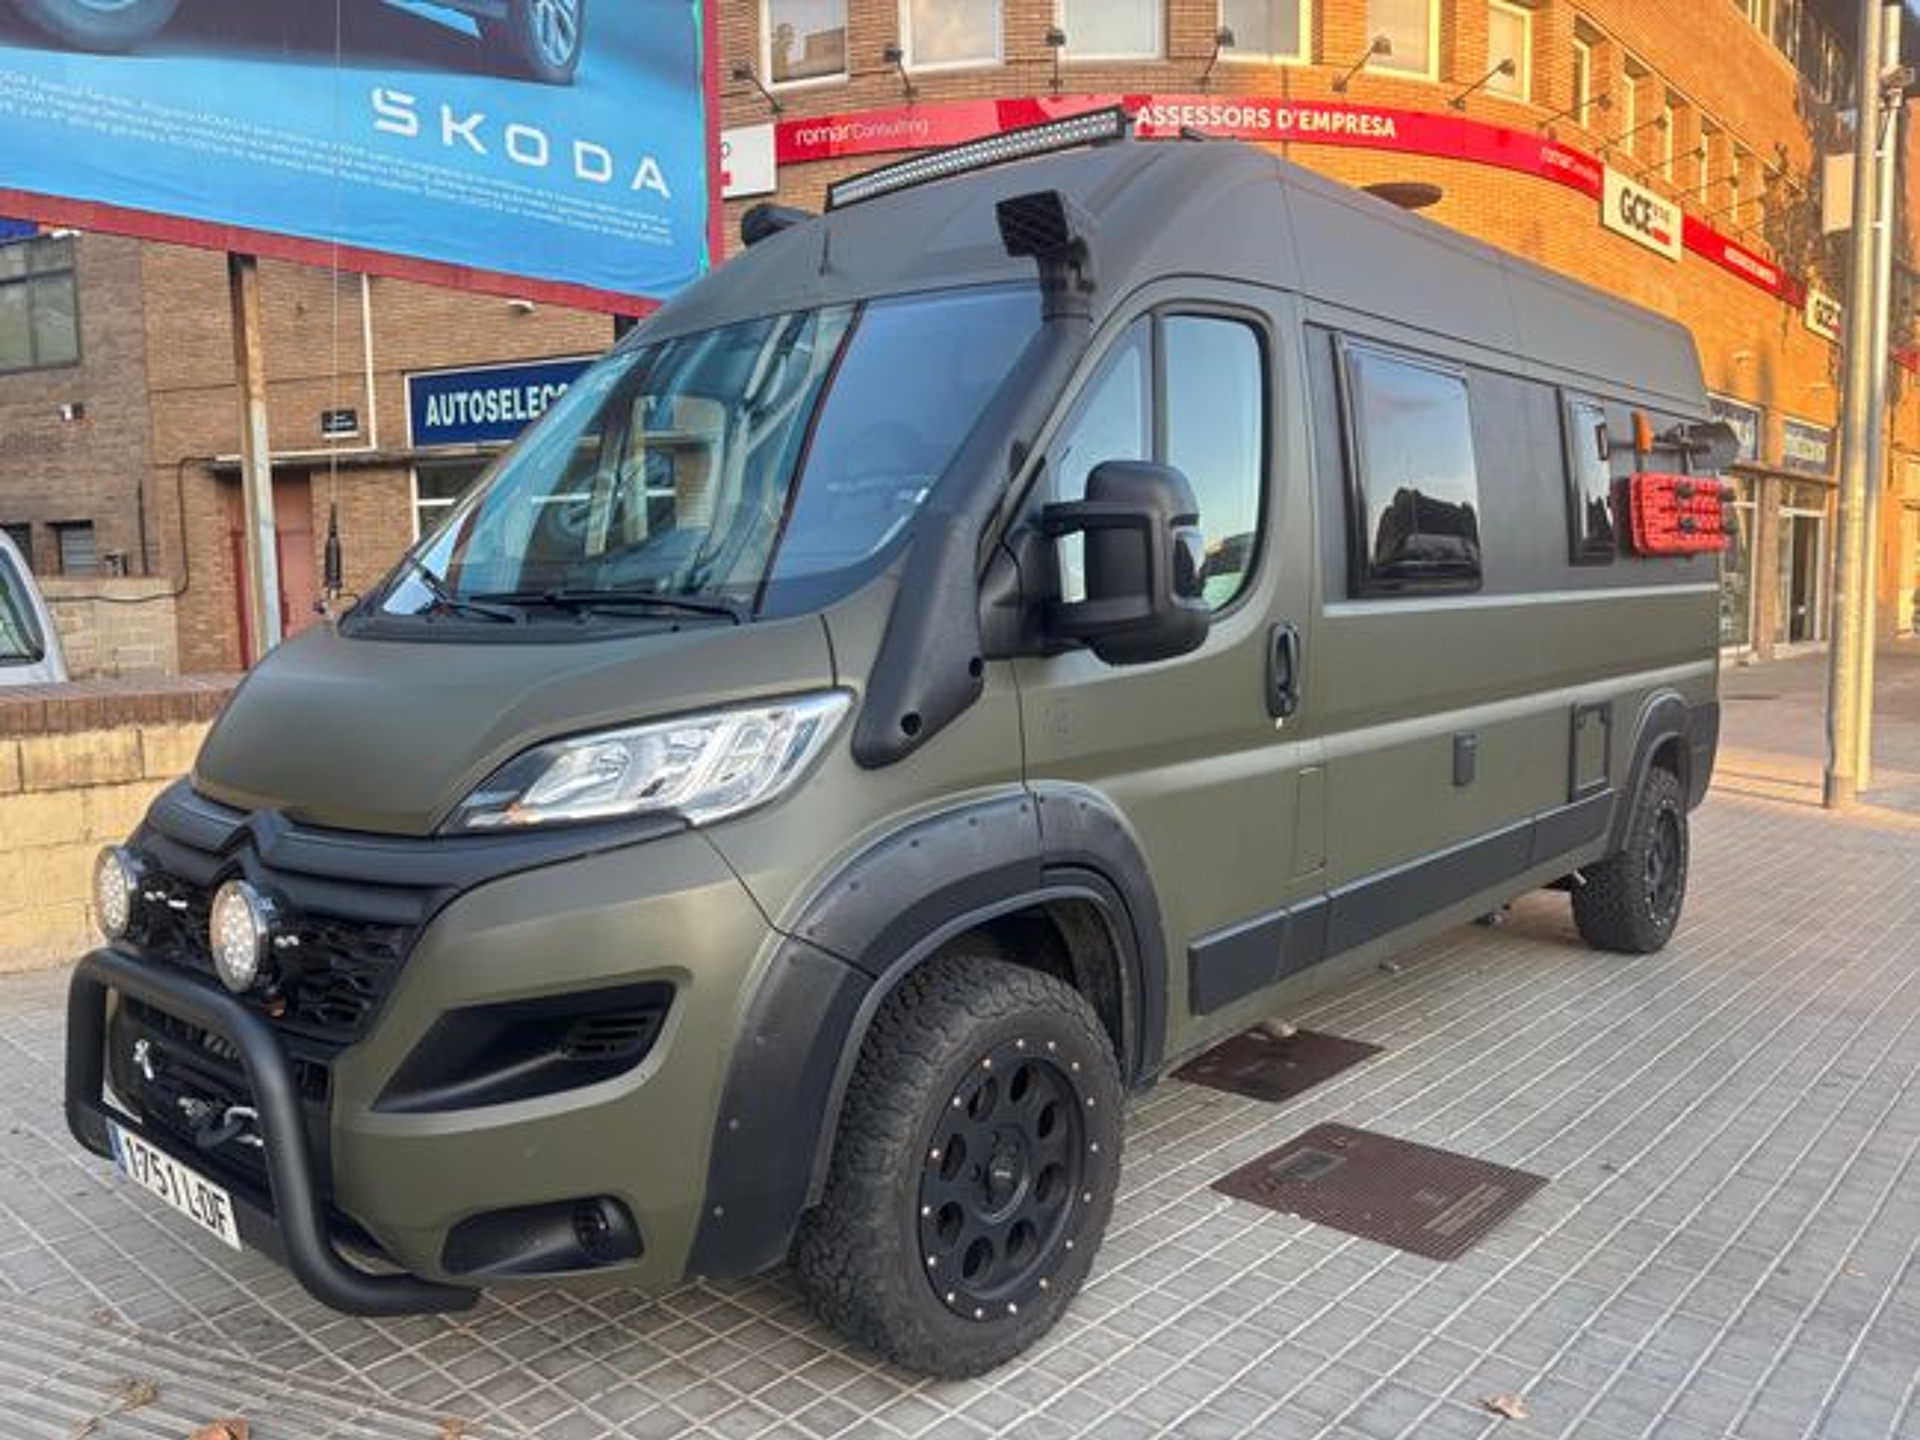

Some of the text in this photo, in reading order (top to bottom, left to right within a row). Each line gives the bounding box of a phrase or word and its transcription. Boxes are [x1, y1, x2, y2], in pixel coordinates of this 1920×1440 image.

[1136, 105, 1396, 138] ASSESSORS D'EMPRESA
[1619, 187, 1653, 237] GCE
[126, 1137, 182, 1205] 1751
